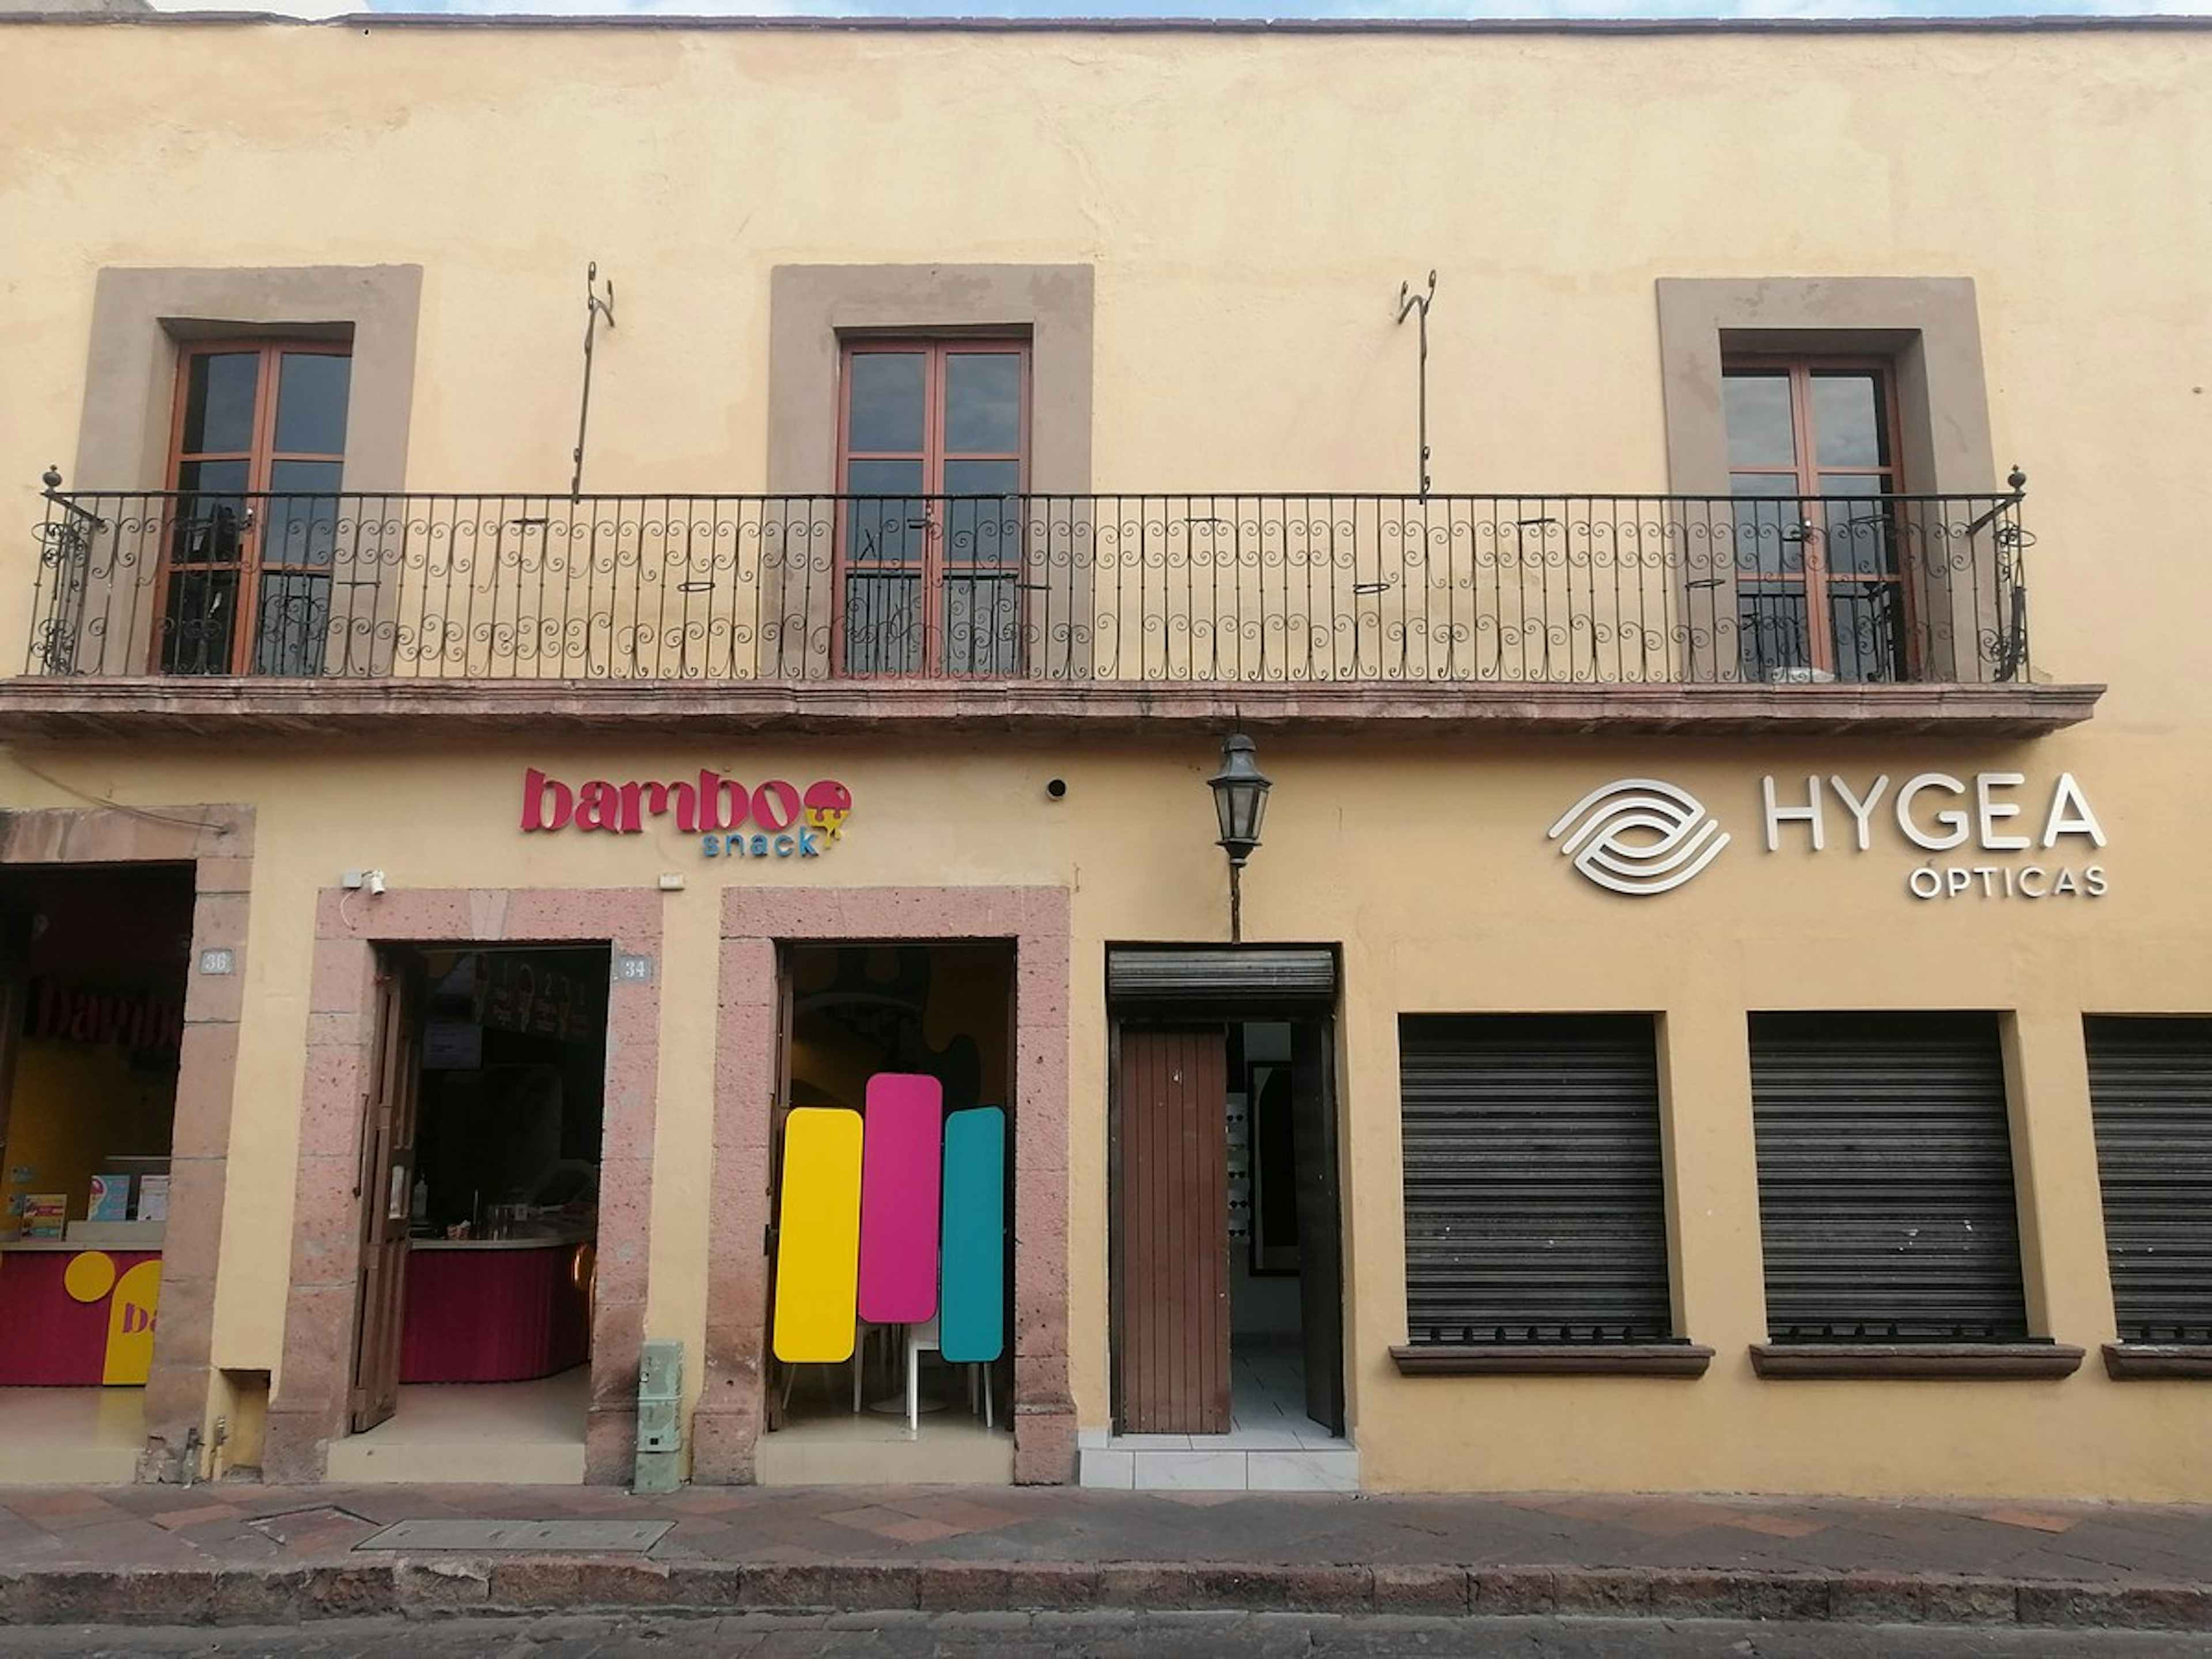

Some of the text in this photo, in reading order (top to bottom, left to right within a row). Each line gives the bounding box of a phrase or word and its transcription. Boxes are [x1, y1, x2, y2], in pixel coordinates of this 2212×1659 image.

[1762, 771, 2108, 851] HYGEA
[702, 826, 819, 857] snack
[206, 954, 226, 970] 36
[626, 961, 646, 977] 34
